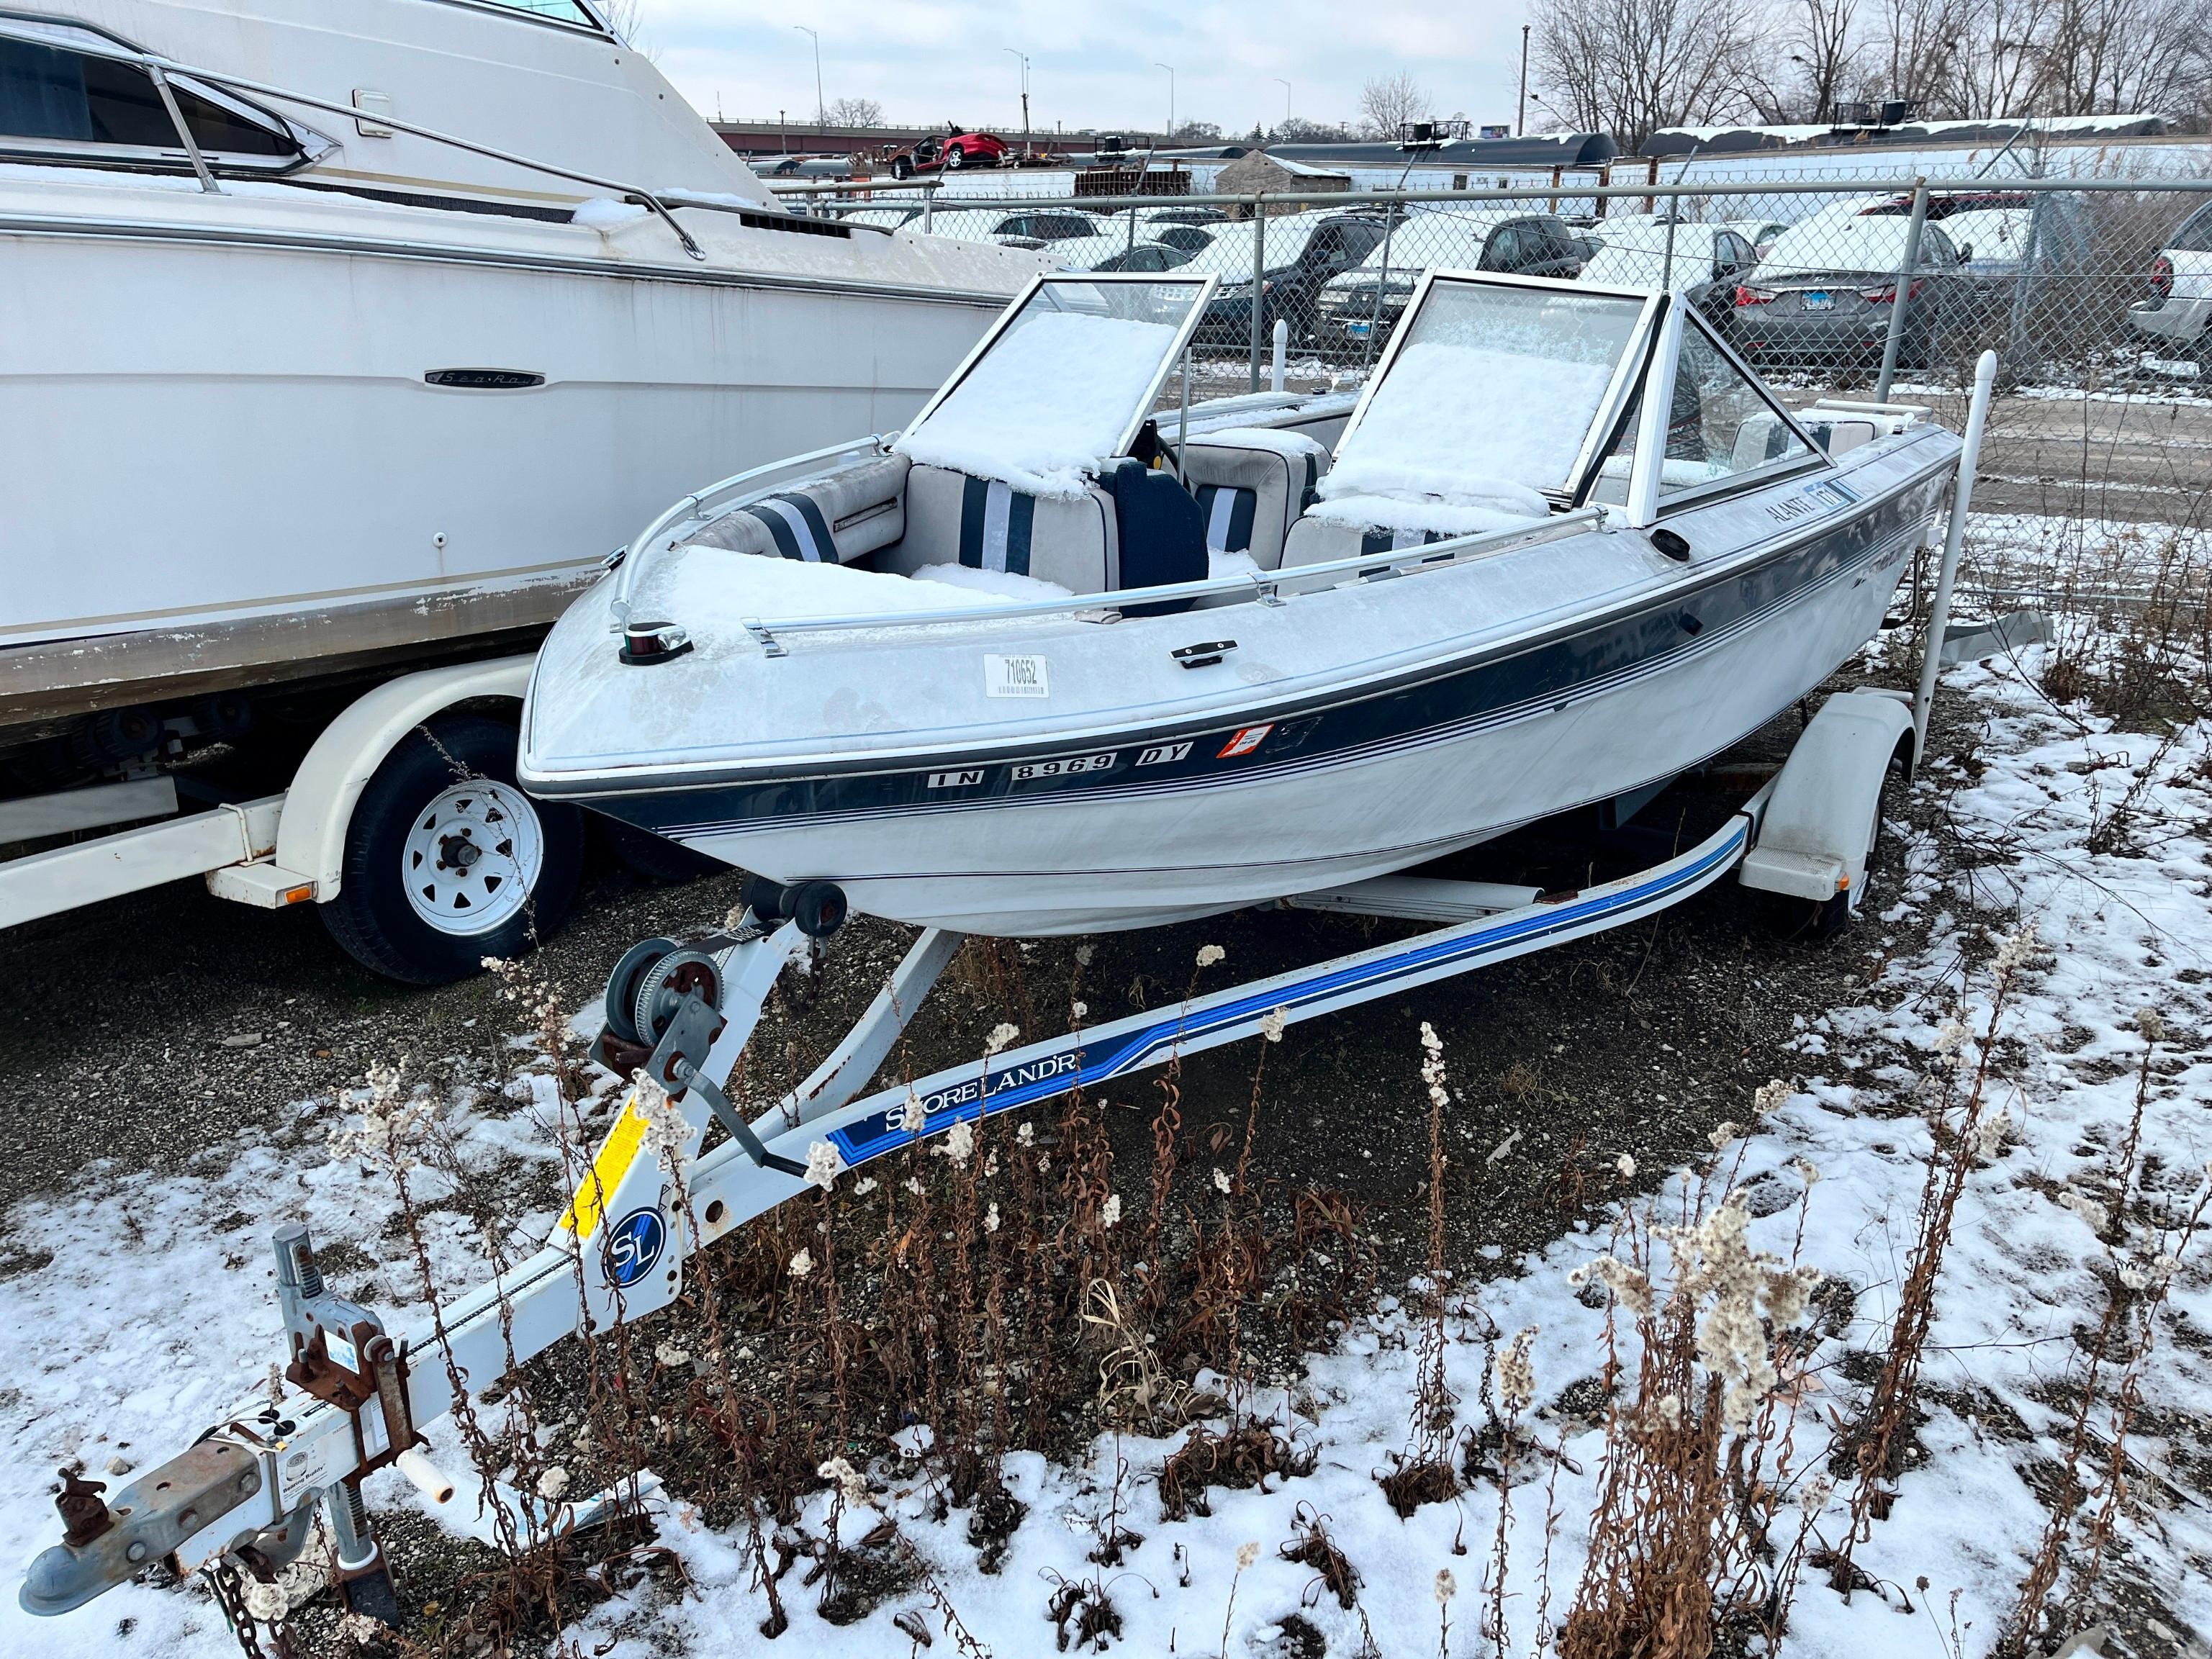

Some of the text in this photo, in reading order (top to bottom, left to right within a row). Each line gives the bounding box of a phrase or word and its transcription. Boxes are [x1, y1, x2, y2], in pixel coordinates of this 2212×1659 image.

[443, 373, 484, 383] Sea
[1765, 497, 1815, 524] ALANTE
[1005, 659, 1037, 684] 710652
[937, 743, 1191, 786] IN 8969 DY
[886, 1053, 1077, 1131] SORELAND'R
[611, 1231, 655, 1267] SL
[282, 1478, 306, 1493] Bearing
